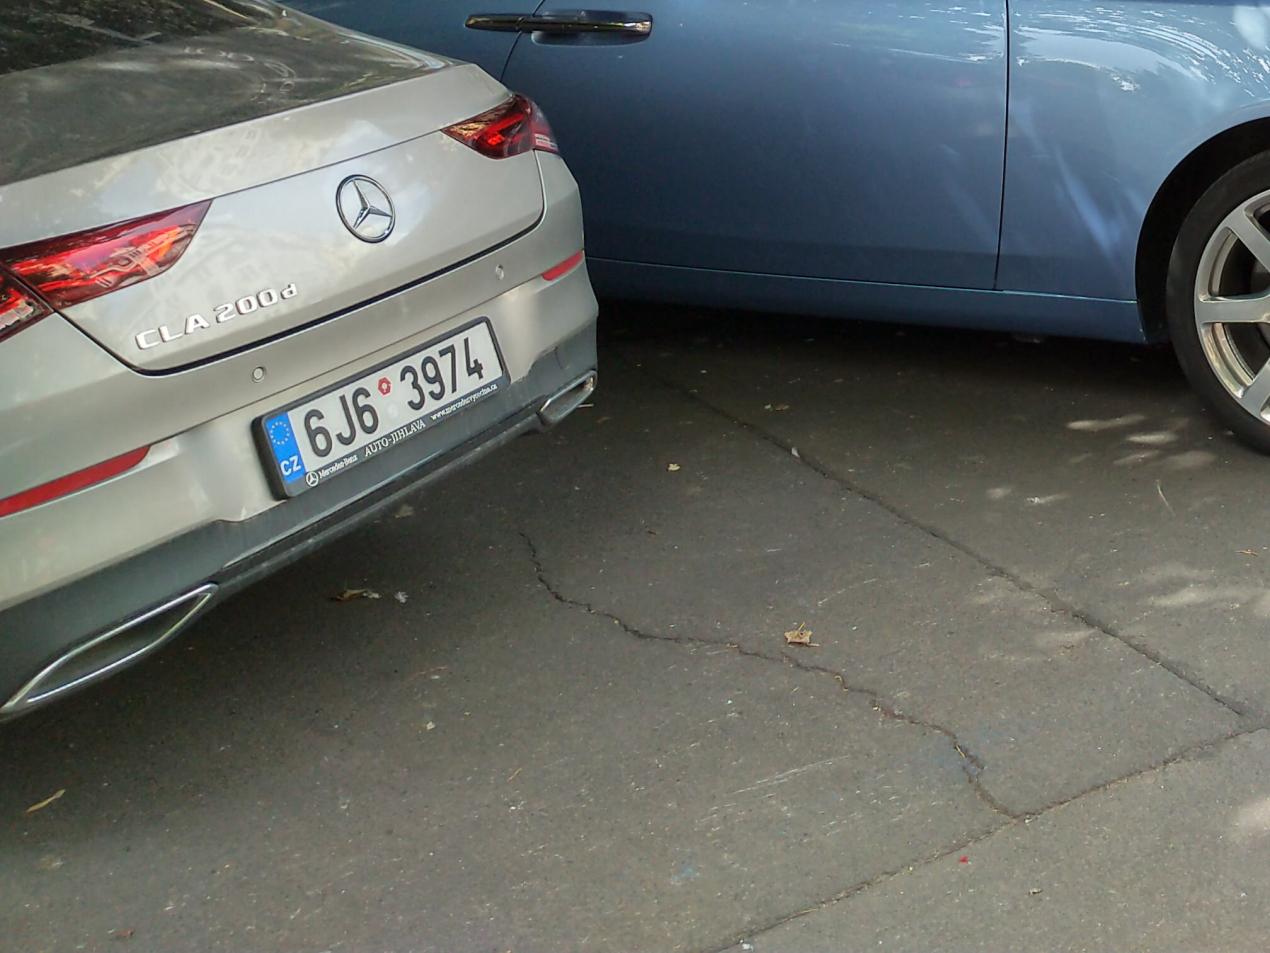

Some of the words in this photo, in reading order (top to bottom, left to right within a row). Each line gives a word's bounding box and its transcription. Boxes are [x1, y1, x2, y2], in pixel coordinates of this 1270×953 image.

[135, 313, 210, 350] CLA
[304, 386, 380, 458] 6J6
[400, 337, 484, 411] 3974
[363, 419, 427, 458] AUTO-JIHLAVA
[280, 454, 302, 477] CZ
